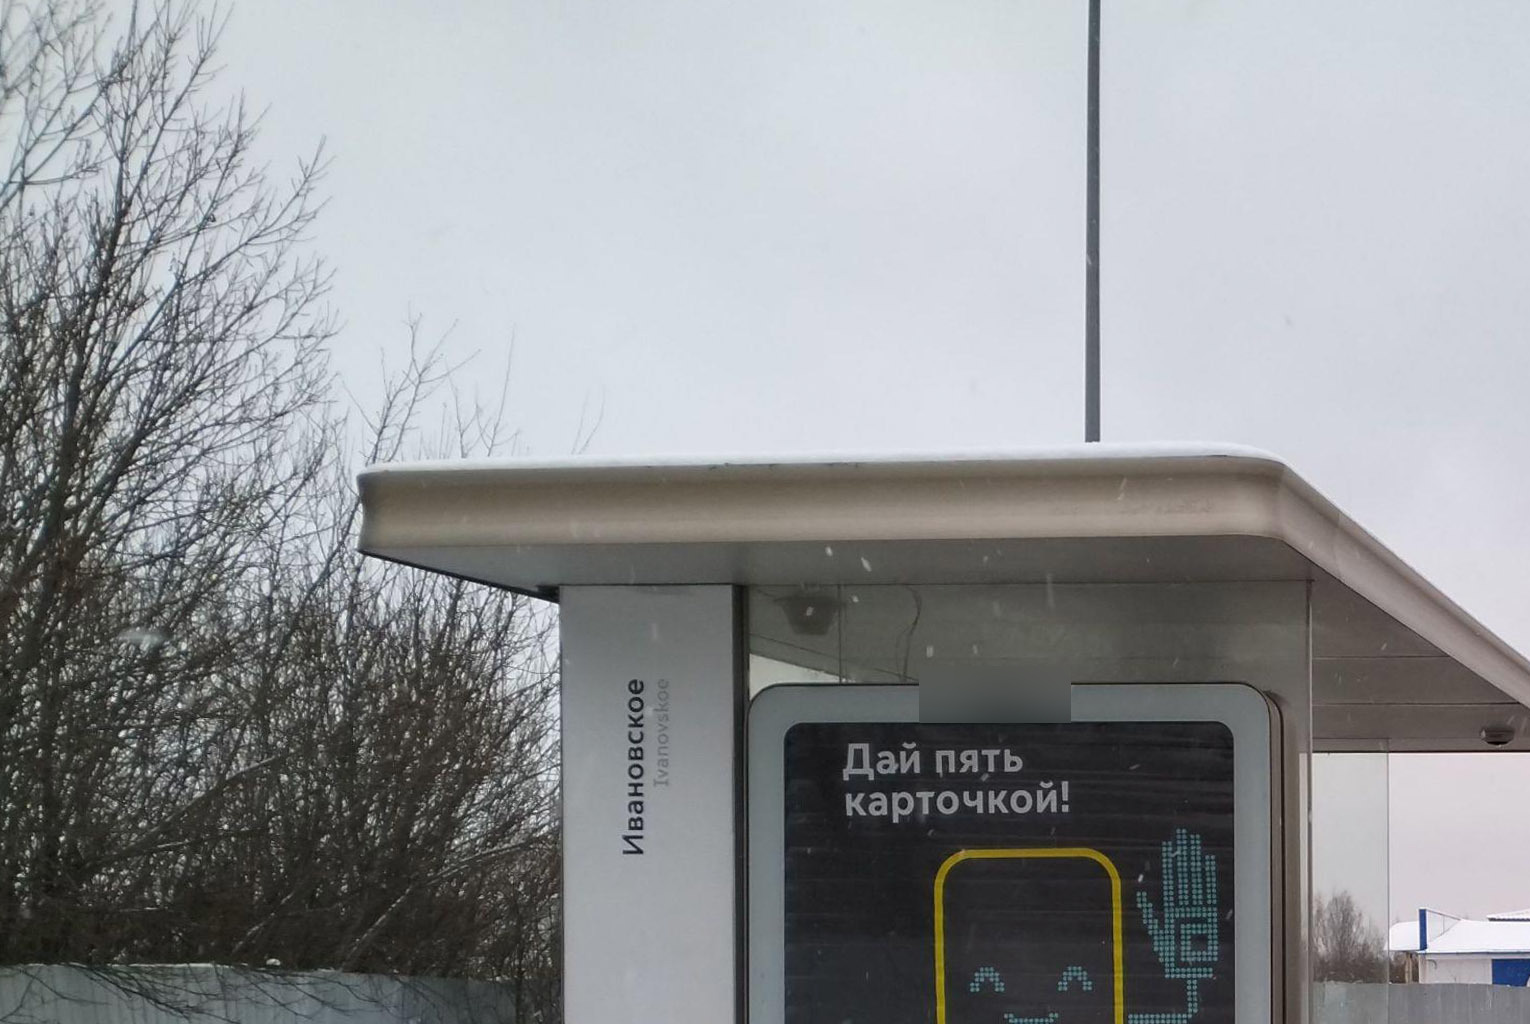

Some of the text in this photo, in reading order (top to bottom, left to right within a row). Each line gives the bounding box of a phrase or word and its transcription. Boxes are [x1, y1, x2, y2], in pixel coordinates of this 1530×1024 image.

[622, 679, 644, 855] Ивановское
[653, 678, 669, 788] Ivanovskoe
[842, 741, 1024, 781] Дай пять
[844, 780, 1070, 823] карточкой!
